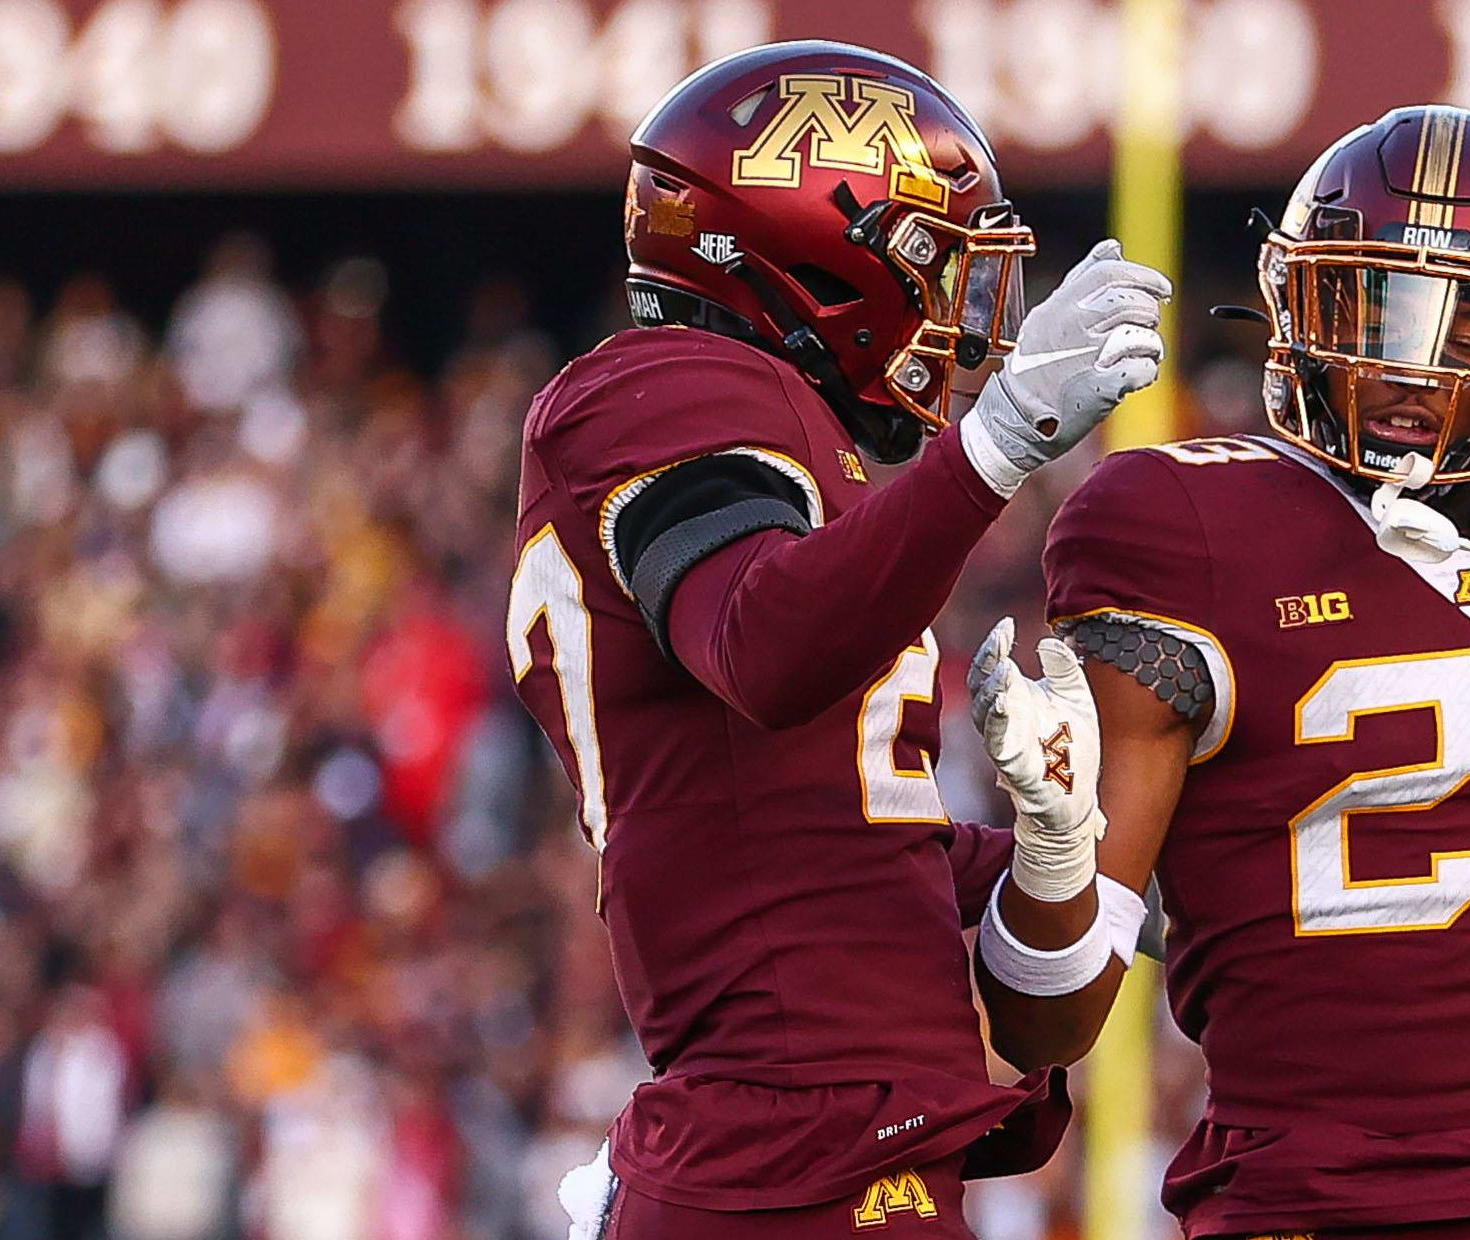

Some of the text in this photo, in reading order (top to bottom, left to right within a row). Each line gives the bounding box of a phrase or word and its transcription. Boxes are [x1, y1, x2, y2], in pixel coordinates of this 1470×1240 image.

[731, 74, 949, 213] M
[697, 232, 740, 264] HERE
[1403, 226, 1452, 248] ROW
[506, 521, 608, 856] 7
[877, 1114, 925, 1140] DRI-FIT
[852, 1168, 940, 1233] M
